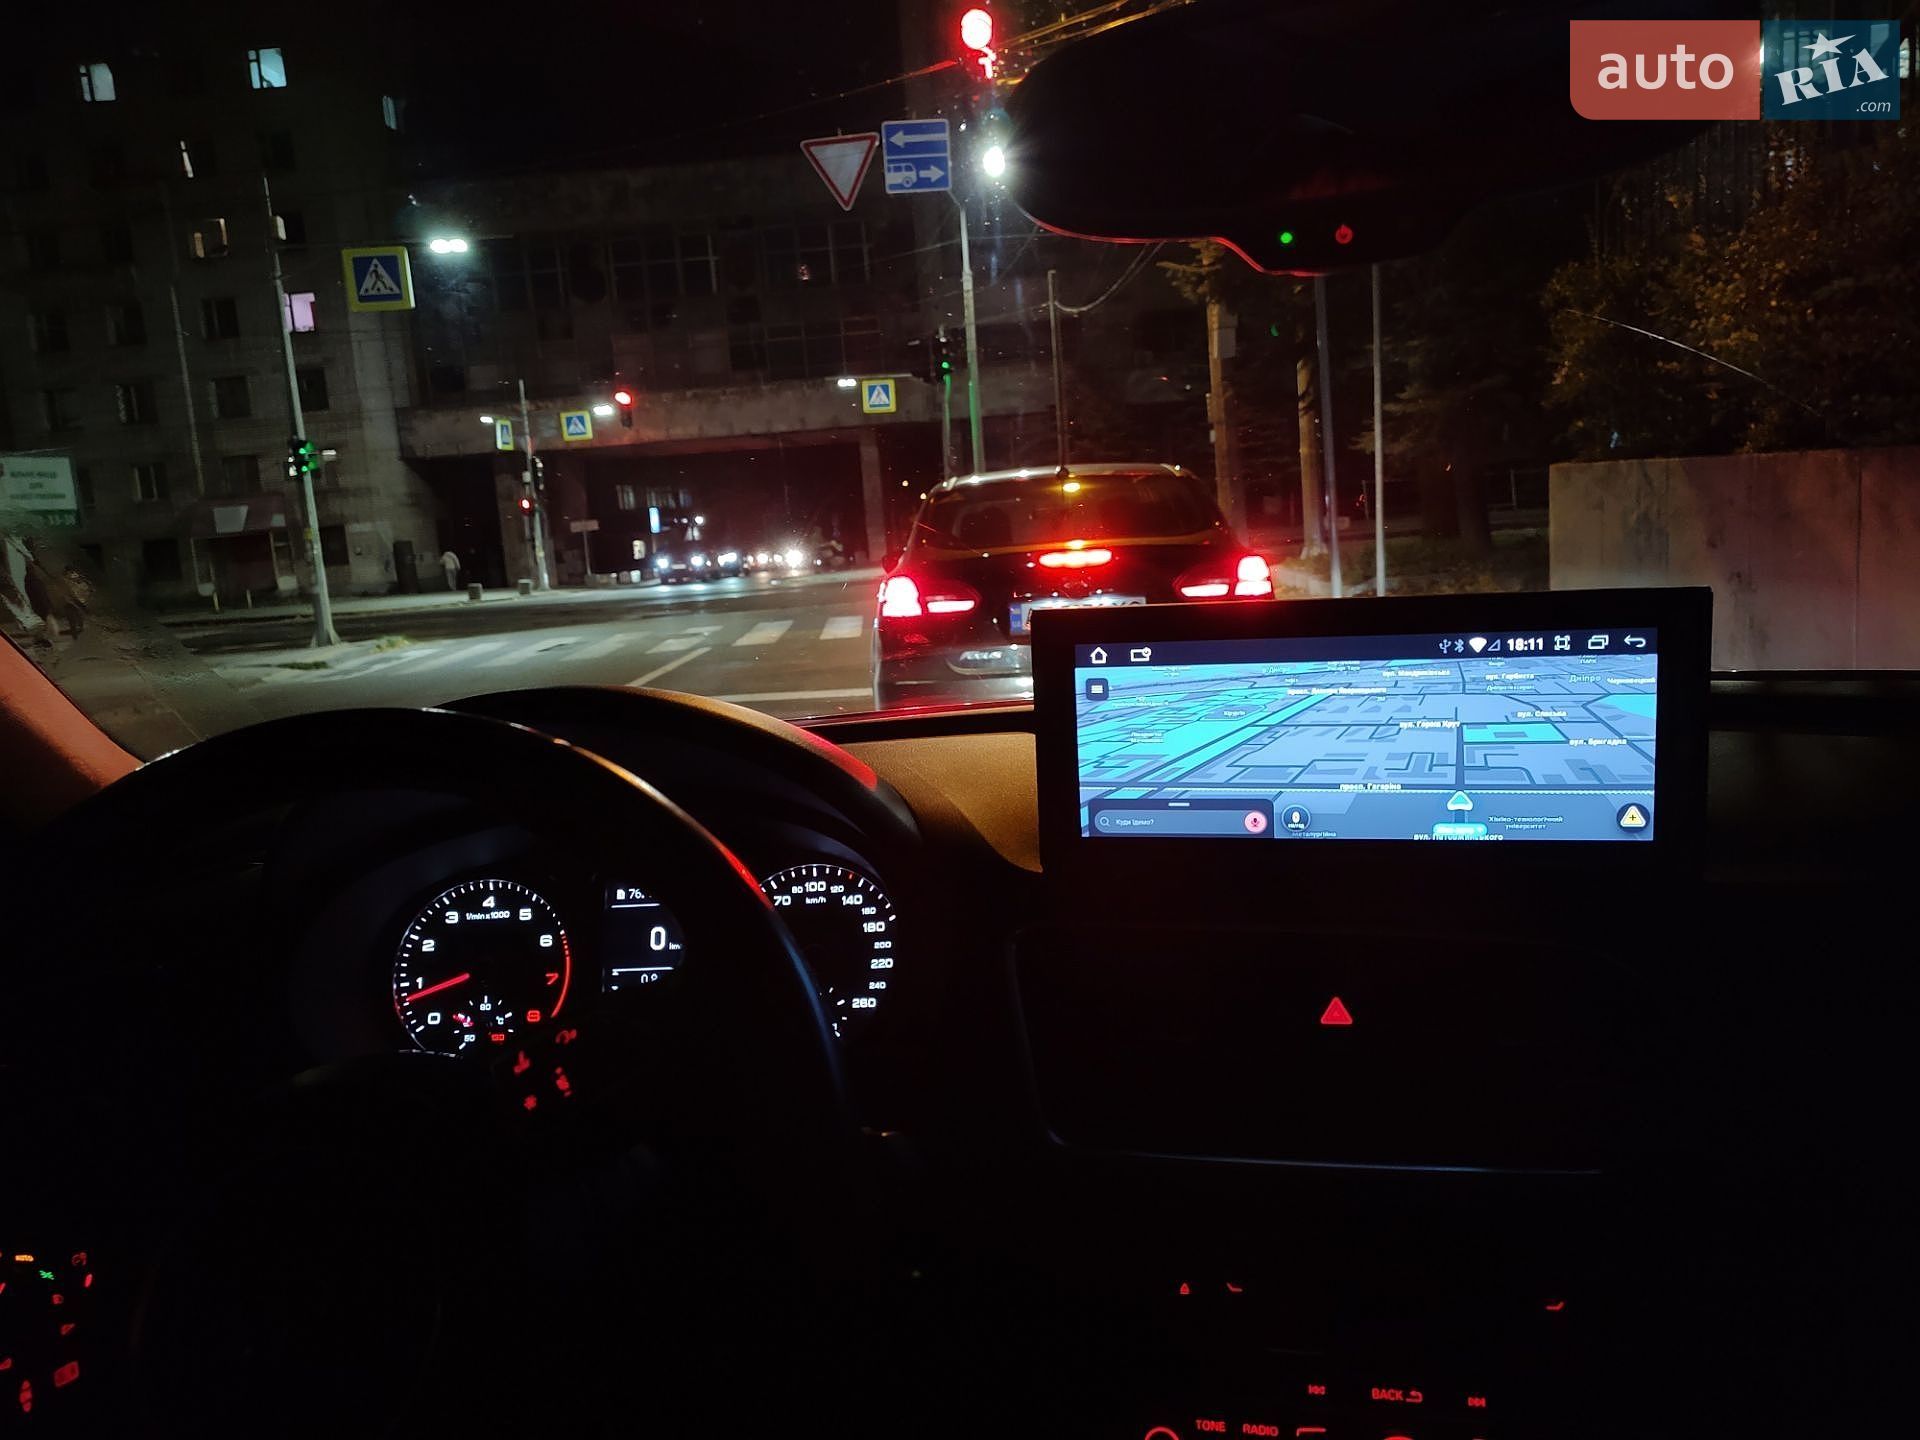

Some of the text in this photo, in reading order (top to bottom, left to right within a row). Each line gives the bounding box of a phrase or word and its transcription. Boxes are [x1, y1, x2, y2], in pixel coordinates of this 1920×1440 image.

[1507, 637, 1544, 651] 18:11
[805, 881, 826, 892] 100
[830, 885, 845, 893] 120
[482, 896, 495, 908] 4
[773, 895, 792, 906] 70
[805, 896, 827, 904] km/h
[842, 895, 863, 905] 140
[445, 911, 459, 924] 3
[519, 908, 532, 921] 5
[863, 921, 886, 933] 180
[539, 934, 553, 947] 6
[649, 926, 666, 951] 0
[422, 939, 435, 952] 2
[874, 941, 892, 949] 200
[870, 958, 894, 969] 220
[416, 976, 423, 989] 1
[545, 973, 559, 985] 7
[869, 981, 887, 990] 240
[852, 997, 877, 1009] 260
[427, 1012, 441, 1025] 0
[527, 1010, 541, 1022] 8
[1371, 1387, 1404, 1401] BACK
[1195, 1419, 1226, 1433] TONE
[1242, 1423, 1279, 1437] RADIO
